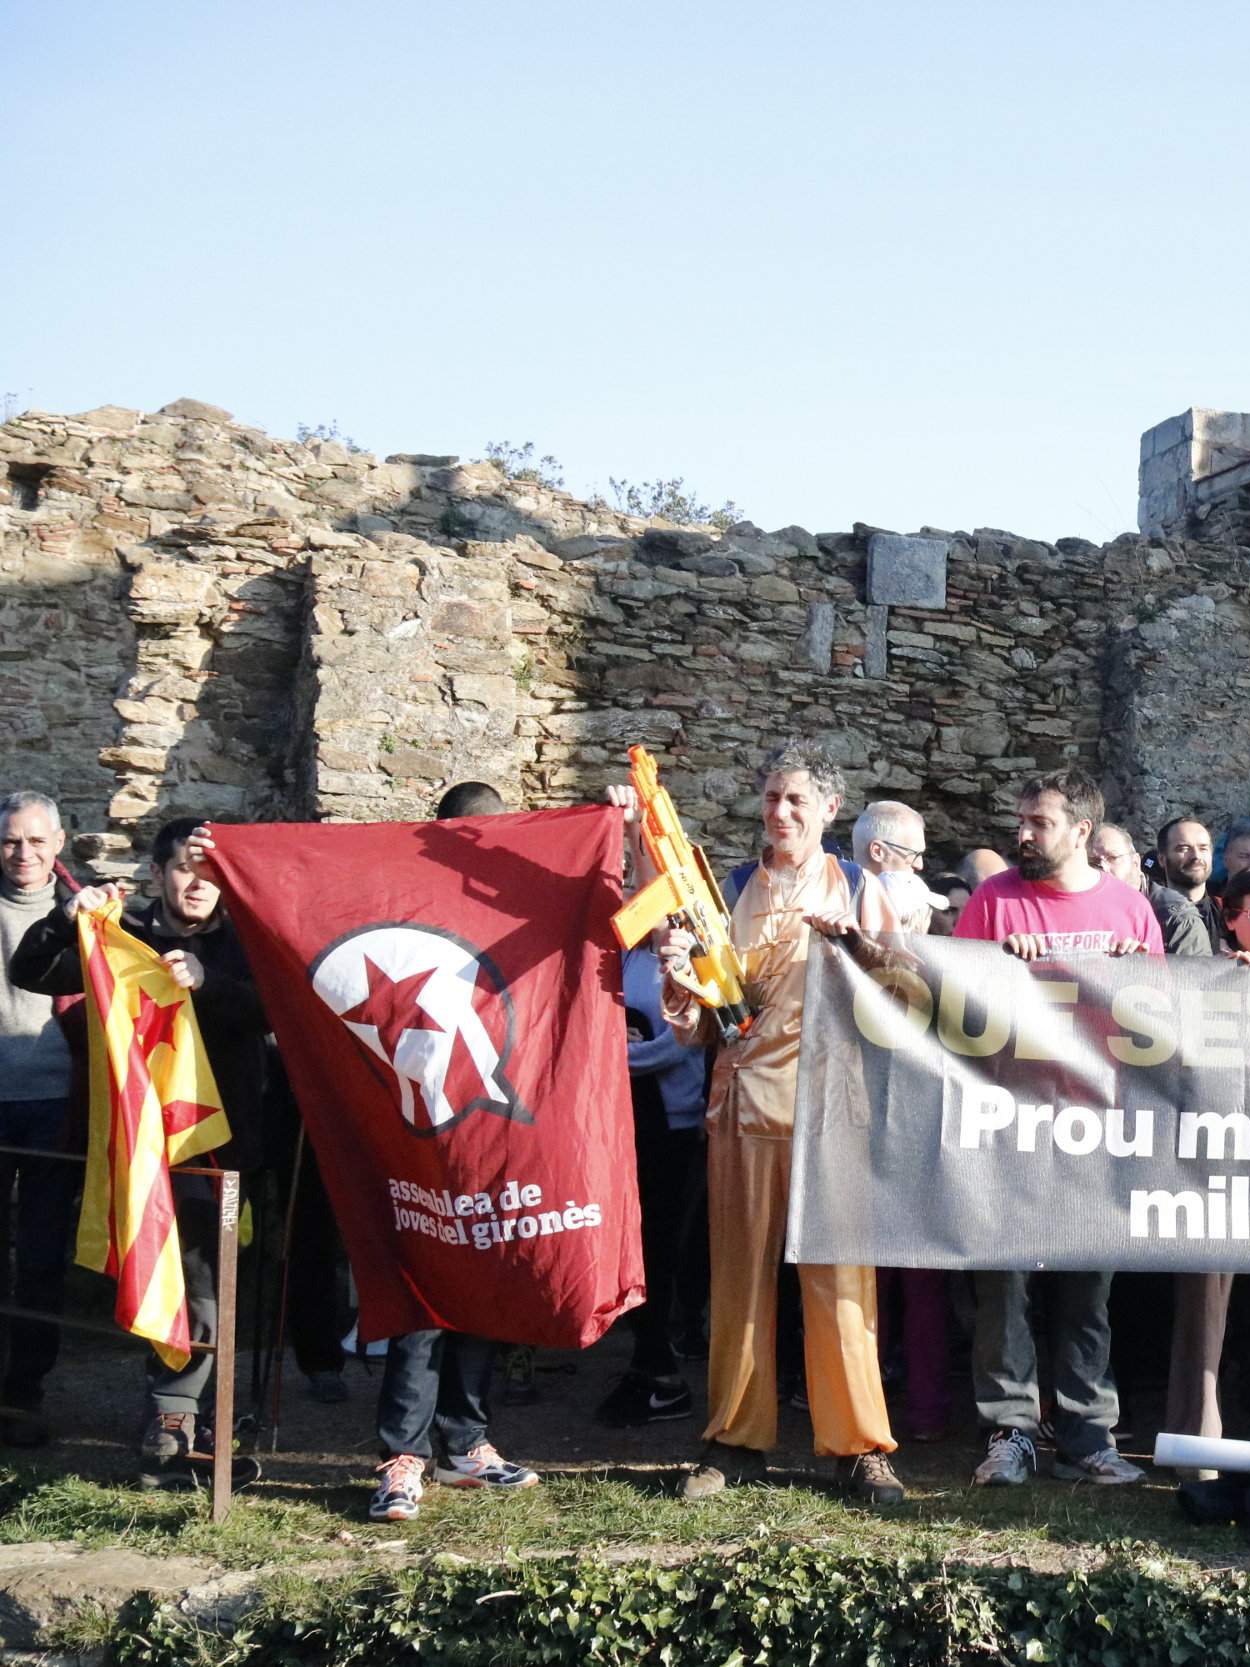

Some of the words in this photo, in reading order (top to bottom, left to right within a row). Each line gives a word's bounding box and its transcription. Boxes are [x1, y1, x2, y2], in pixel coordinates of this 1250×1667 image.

[959, 1084, 1155, 1158] Prou
[388, 1178, 495, 1219] assemblea
[499, 1180, 543, 1211] de
[392, 1200, 437, 1238] joves
[471, 1200, 603, 1250] gironès
